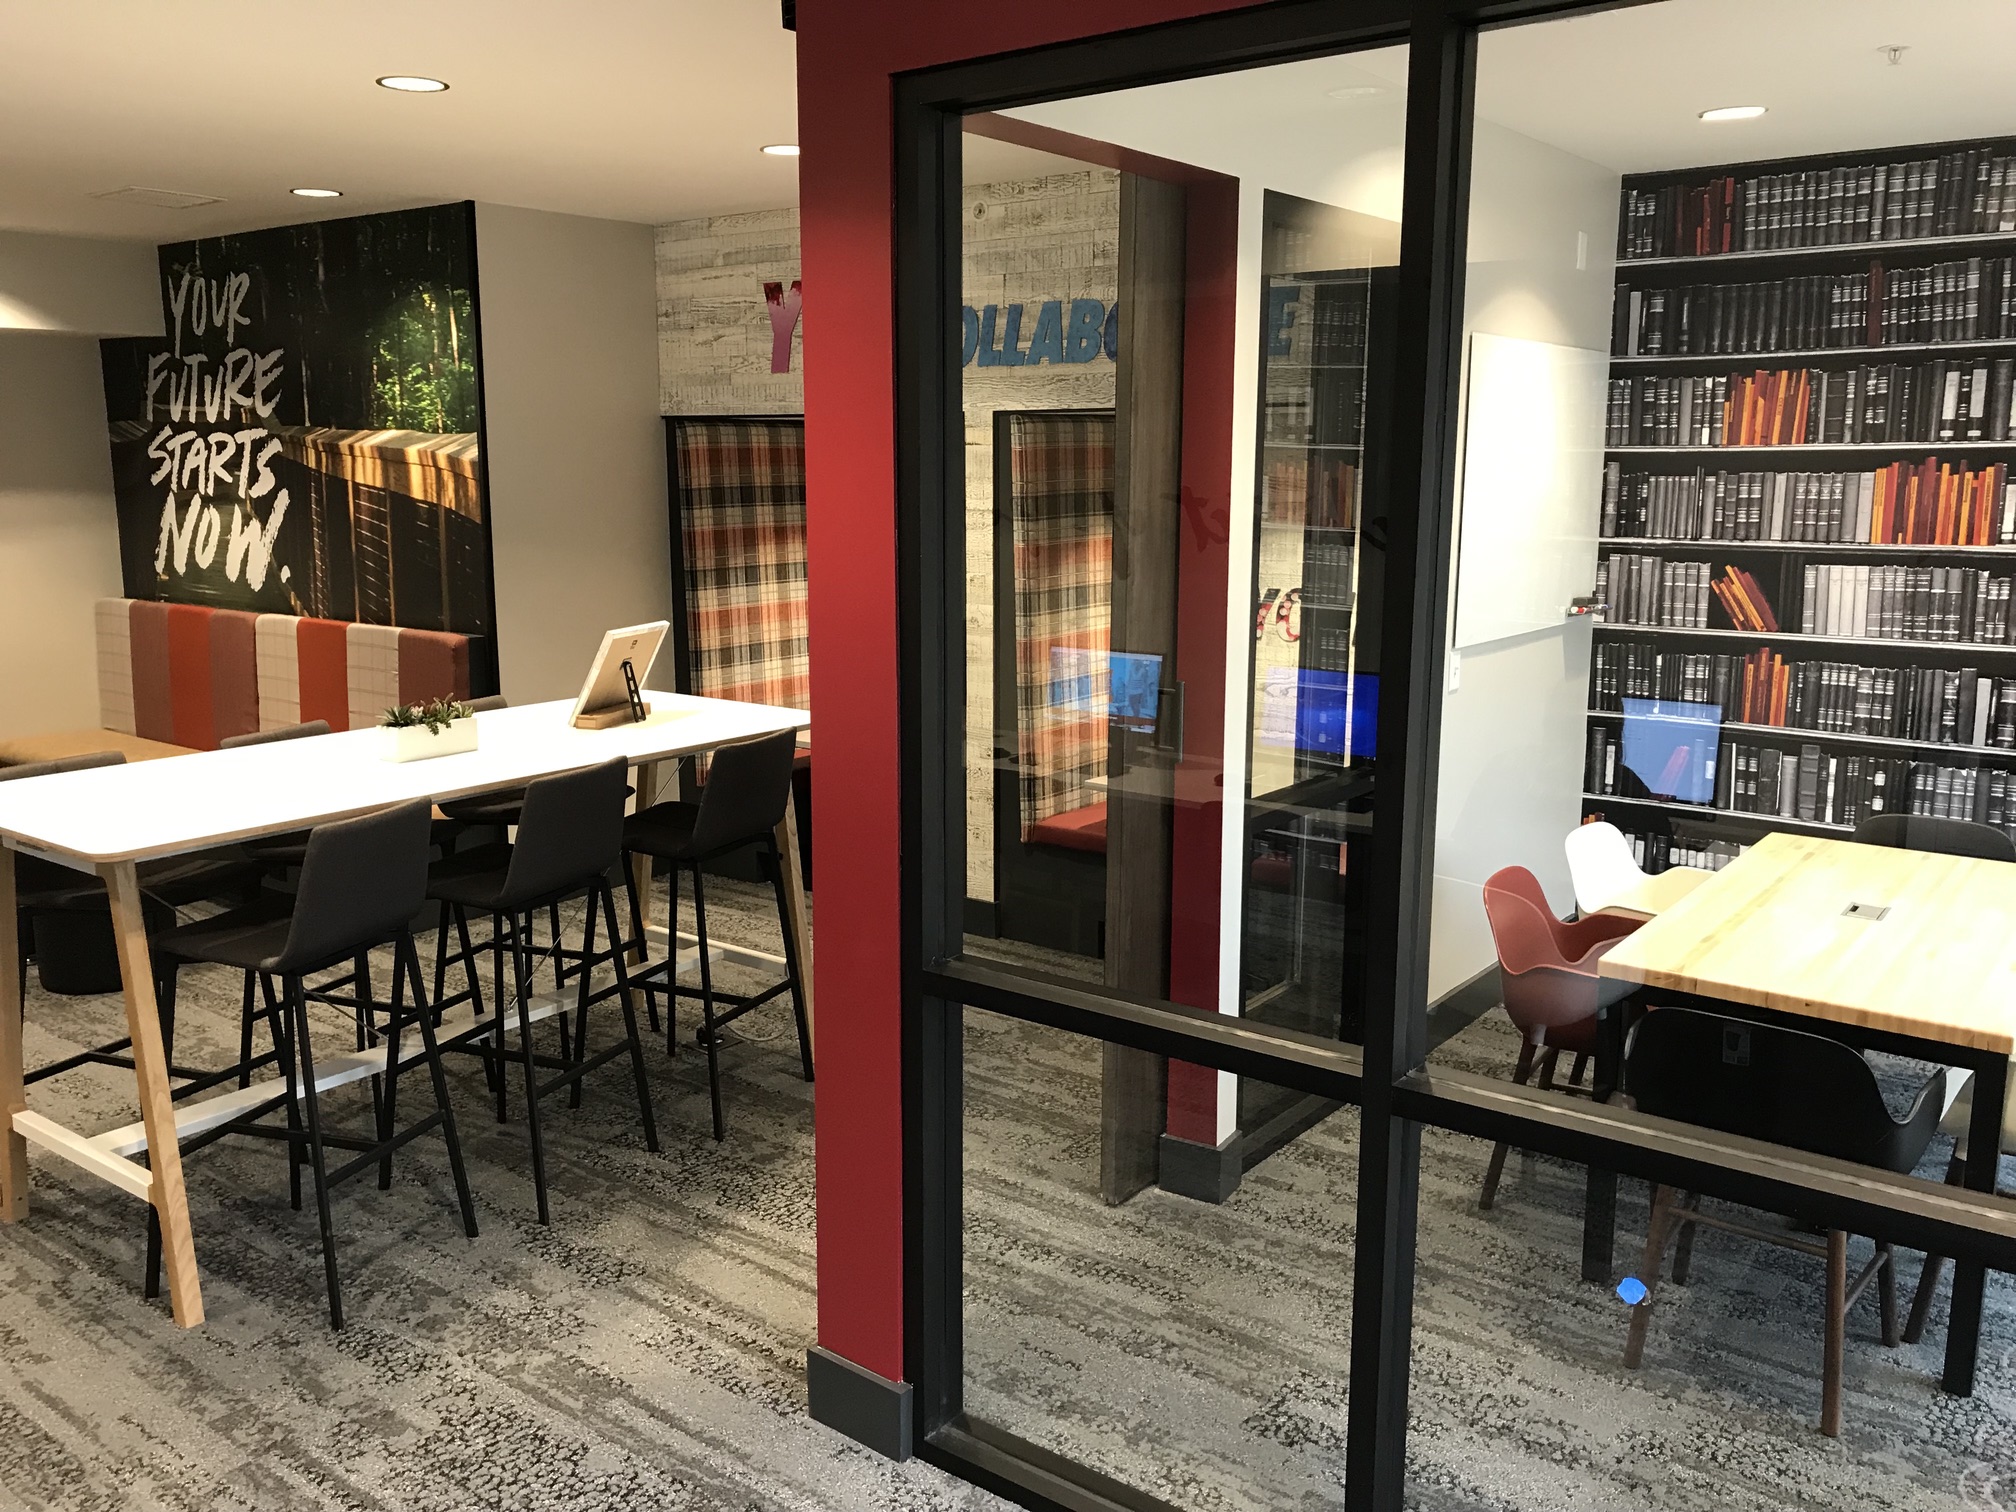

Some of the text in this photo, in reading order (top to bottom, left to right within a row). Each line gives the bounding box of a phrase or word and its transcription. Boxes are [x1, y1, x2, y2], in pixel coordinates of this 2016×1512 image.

[168, 271, 251, 357] YOUR
[147, 347, 285, 423] FUTURE
[148, 425, 283, 498] STARTS
[154, 488, 291, 592] NOW.
